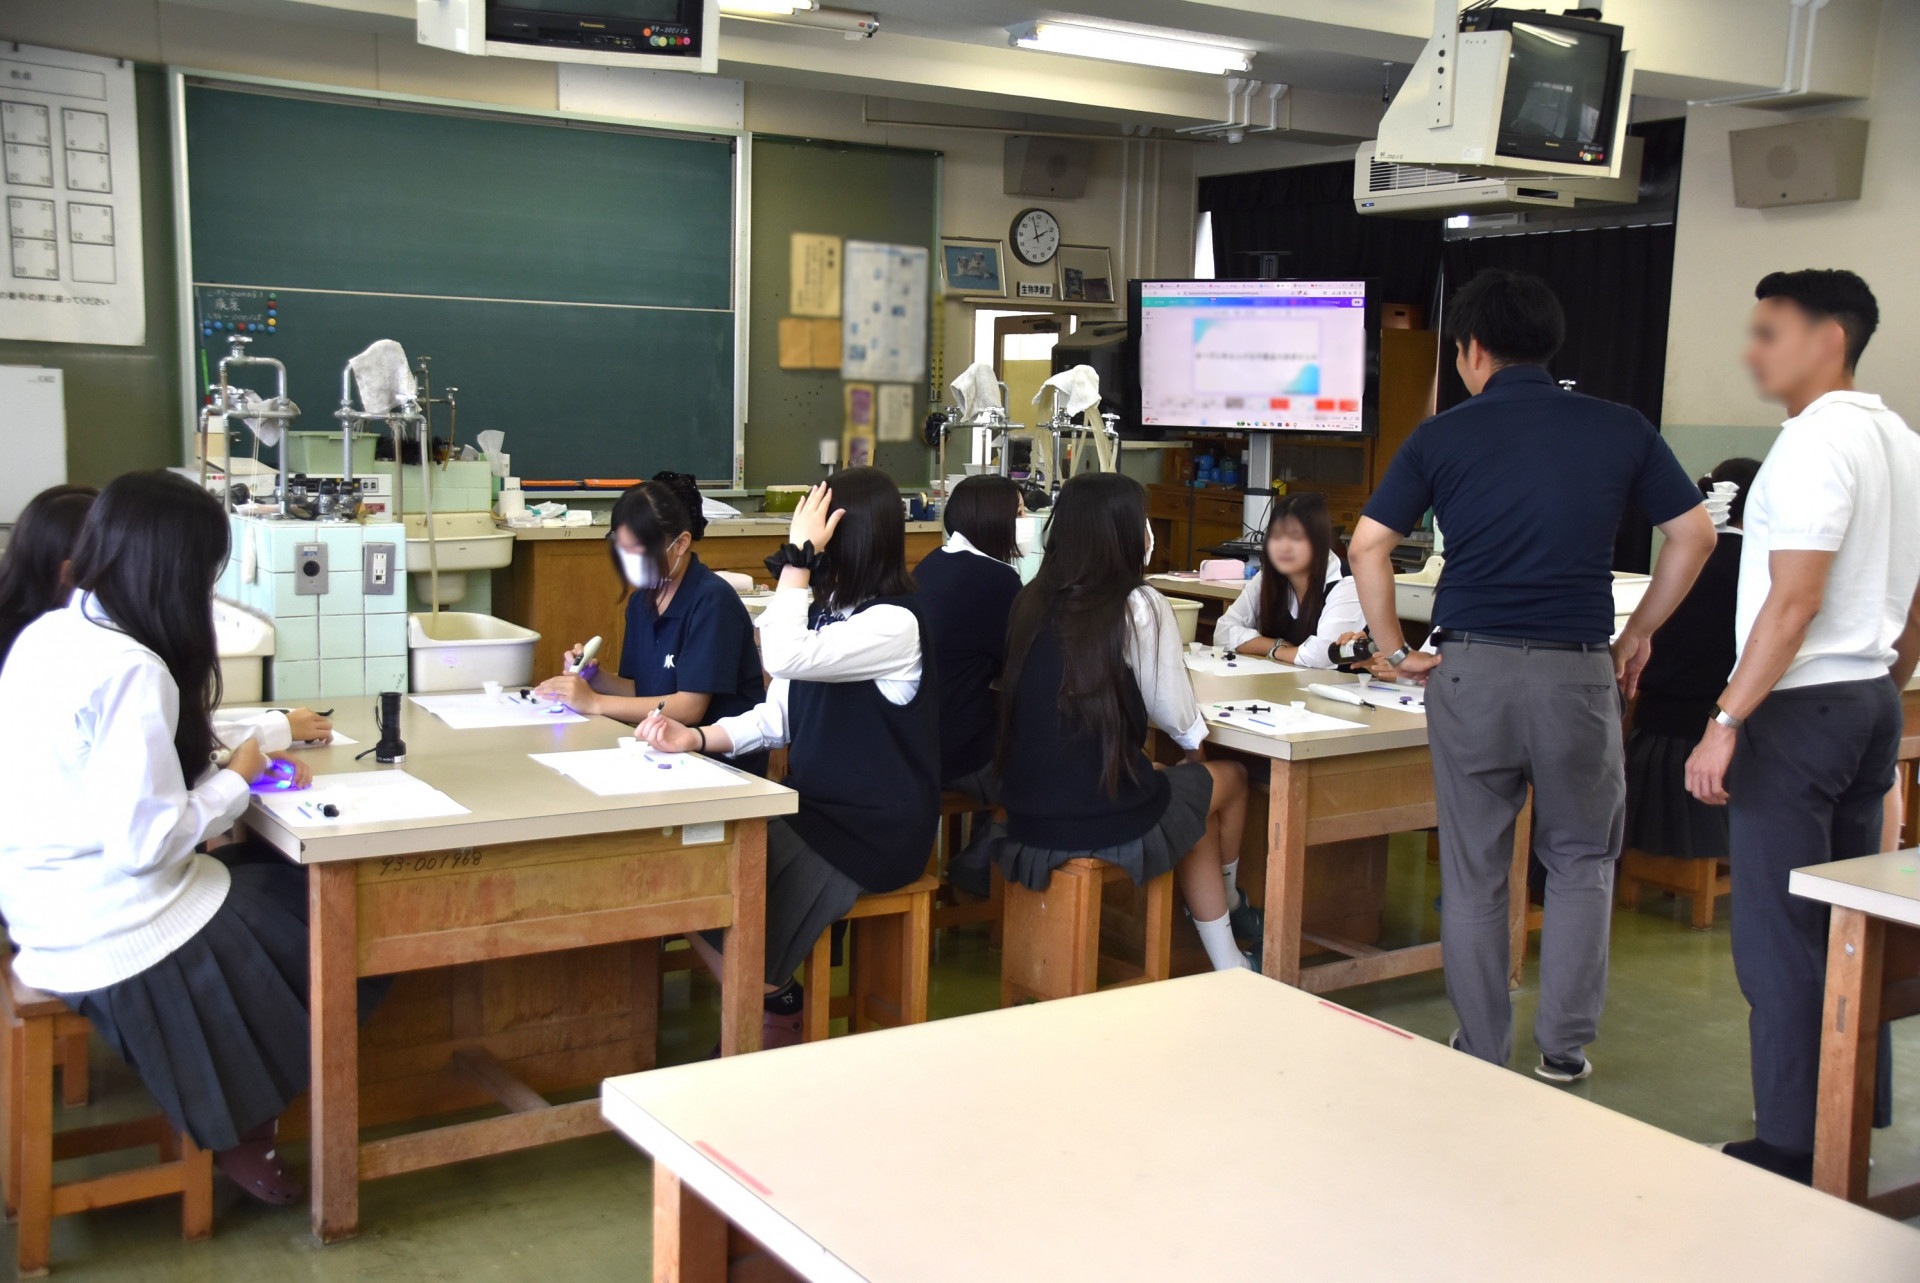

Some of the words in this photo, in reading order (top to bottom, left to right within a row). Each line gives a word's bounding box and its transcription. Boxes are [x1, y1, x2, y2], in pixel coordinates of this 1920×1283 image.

[579, 21, 606, 29] Panasonic
[1021, 284, 1051, 295] 生物準備室
[380, 851, 483, 876] 93-001968
